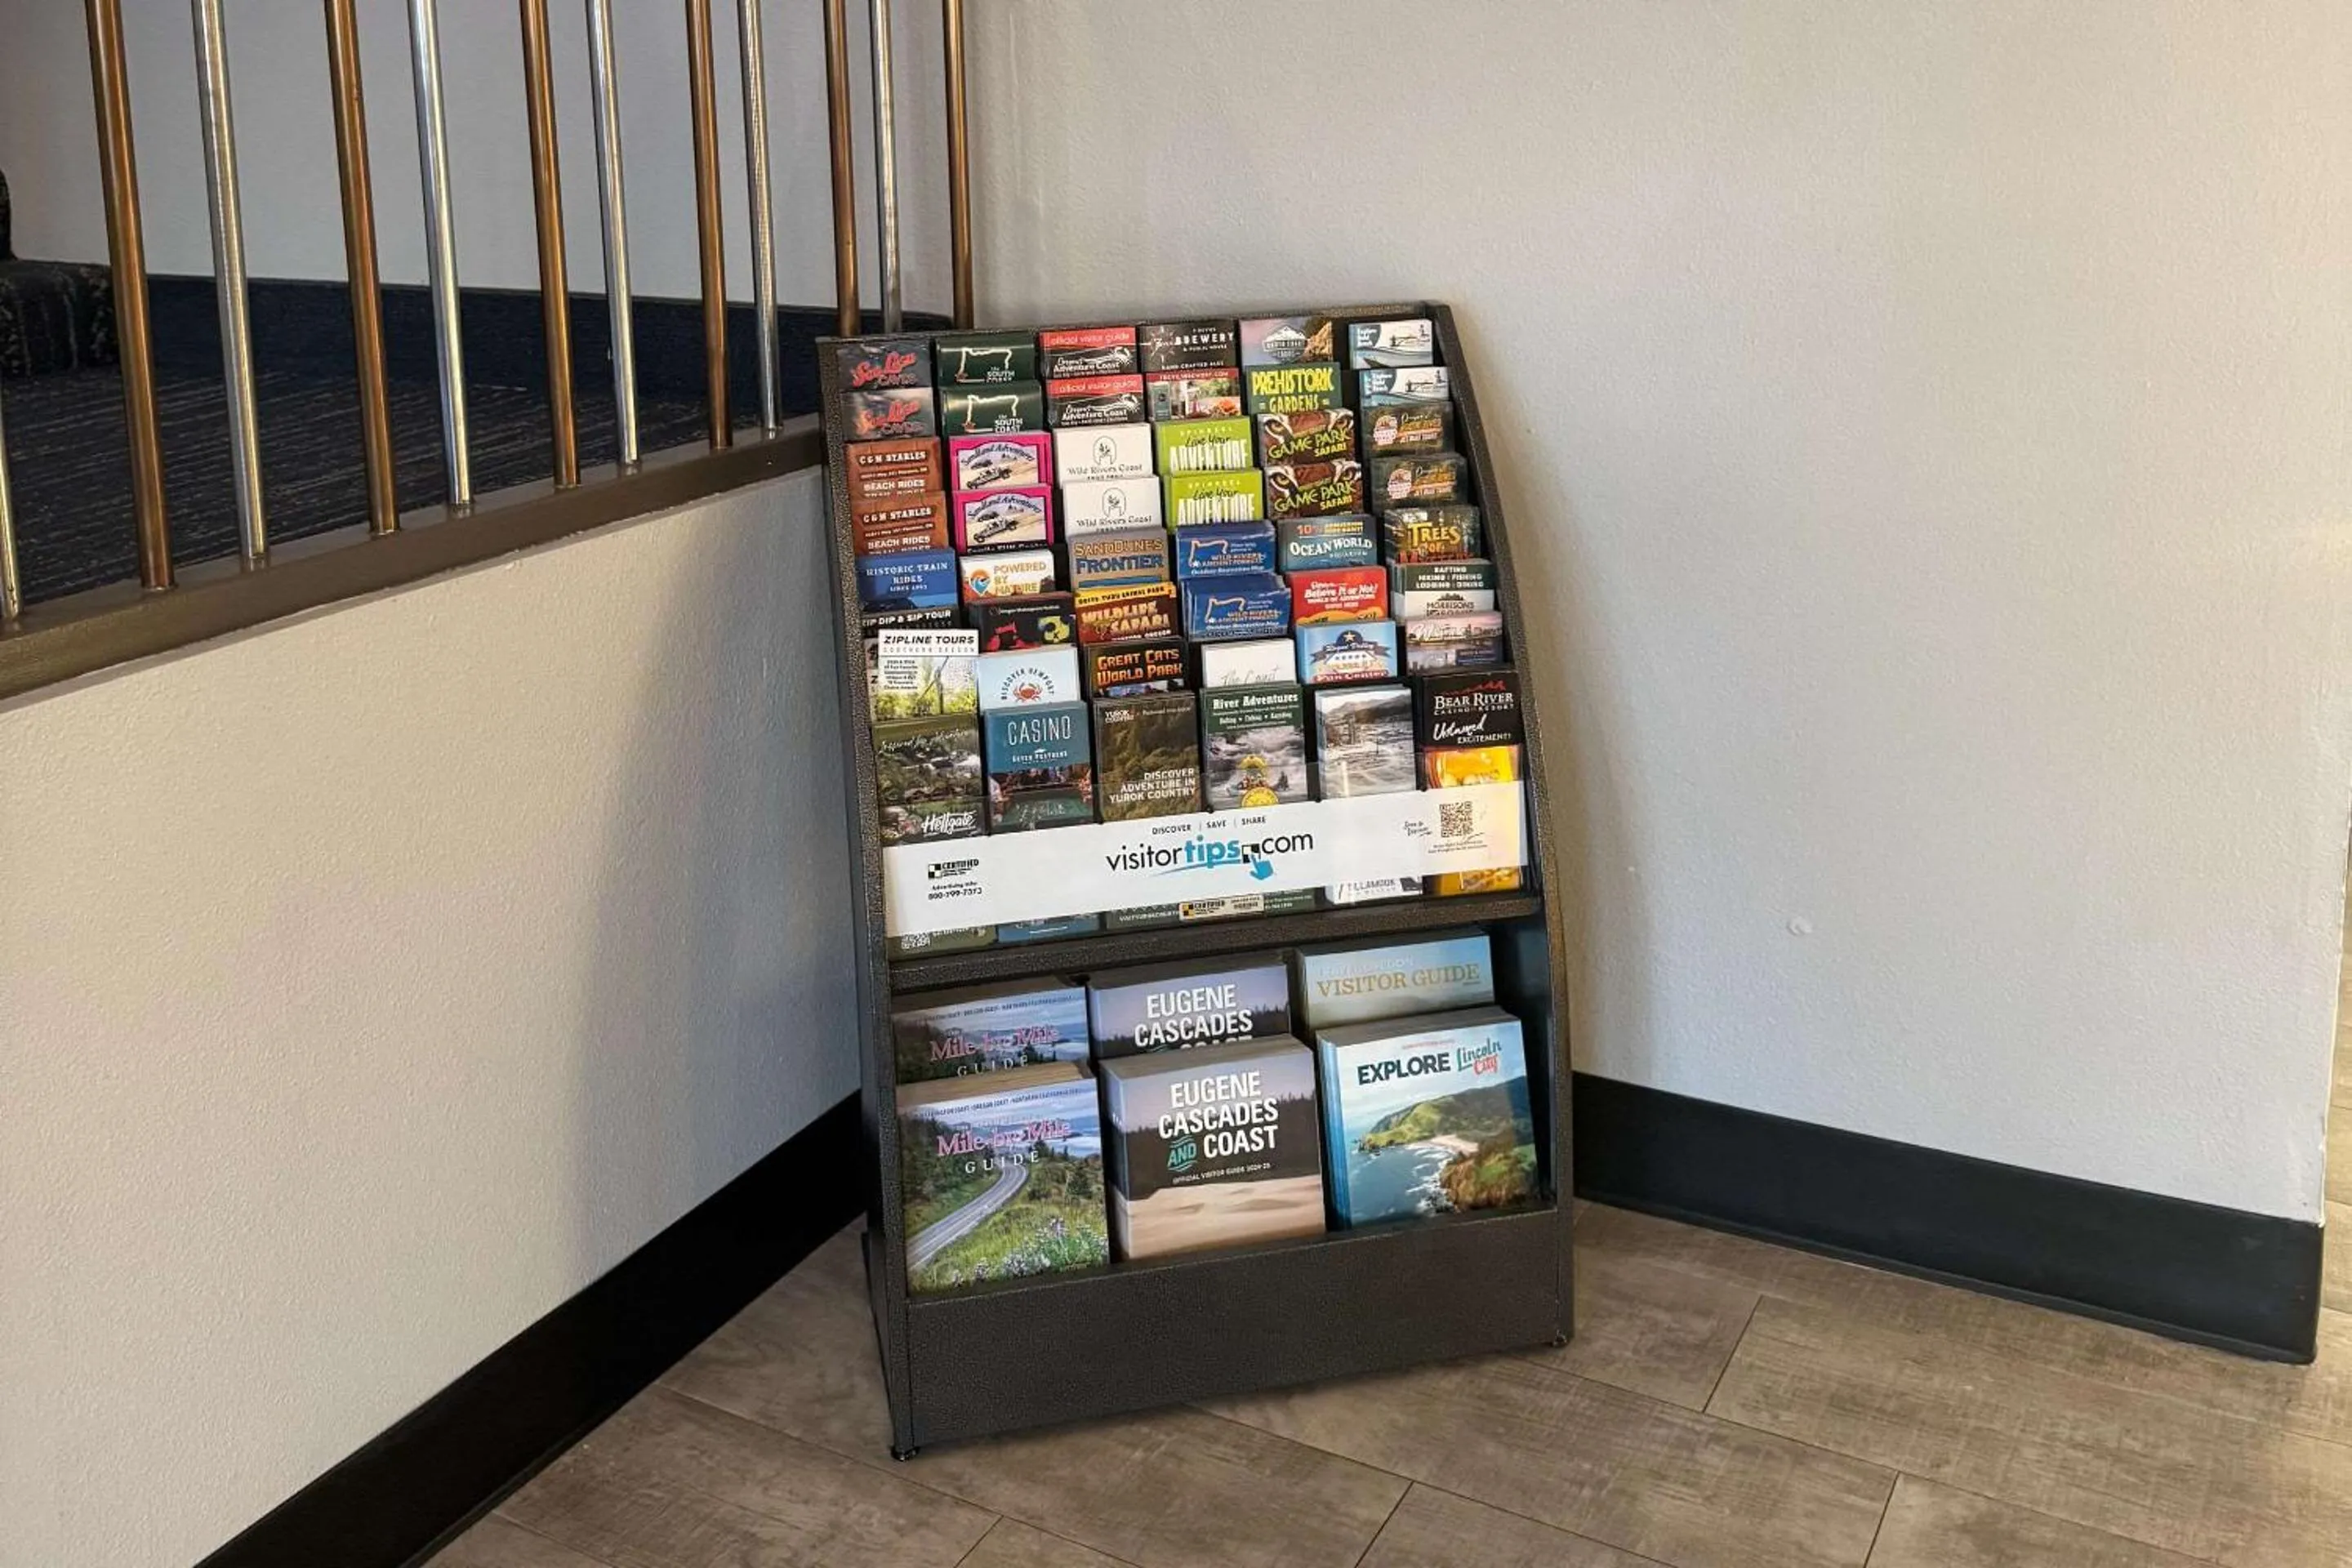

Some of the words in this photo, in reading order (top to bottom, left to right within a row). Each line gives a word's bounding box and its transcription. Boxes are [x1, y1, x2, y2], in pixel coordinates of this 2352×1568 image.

[1106, 332, 1130, 343] guide
[1175, 332, 1234, 345] BREWERY
[1054, 363, 1097, 373] Adventure
[1097, 360, 1120, 369] Coast
[1269, 394, 1320, 412] GARDENS
[994, 417, 1023, 426] SOUTH
[1062, 412, 1102, 421] Adventure
[1102, 409, 1128, 417] Coast
[995, 425, 1021, 434] COAST
[1208, 435, 1232, 447] Your
[1268, 435, 1313, 459] GAME
[1314, 428, 1352, 448] PARK
[886, 451, 927, 462] STABLES
[1169, 439, 1248, 471] ADVENTURE
[1313, 443, 1347, 457] SAFARI
[1067, 466, 1089, 475] Wild
[1118, 463, 1143, 472] Coast
[862, 479, 896, 491] BEACH
[898, 478, 925, 489] RIDES
[1215, 488, 1239, 501] Your
[1273, 488, 1319, 512] GAME
[1320, 480, 1358, 501] PARK
[1178, 493, 1254, 525] ADVENTURE
[1320, 497, 1353, 510] SAFARI
[890, 506, 933, 520] STABLES
[1076, 519, 1098, 528] Wild
[1128, 515, 1152, 524] Coast
[867, 536, 899, 550] BEACH
[902, 535, 931, 547] RIDES
[1407, 522, 1461, 546] TREES
[866, 565, 914, 577] HISTORIC
[917, 562, 948, 572] TRAIN
[993, 561, 1047, 573] POWERED
[1075, 555, 1164, 574] FRONTIER
[893, 575, 924, 585] RIDES
[994, 576, 1008, 585] BY
[994, 582, 1038, 595] NATURE
[1304, 587, 1337, 599] Believe
[879, 617, 897, 626] DIP
[906, 613, 924, 622] SIP
[925, 609, 951, 620] TOUR
[1081, 600, 1158, 623] WILDLIFE
[1111, 613, 1170, 632] SAFARI
[884, 635, 933, 644] ZIPLINE
[935, 635, 975, 644] TOURS
[1097, 652, 1141, 672] GREAT
[1145, 648, 1180, 663] CATS
[1097, 669, 1144, 686] WORLD
[1146, 663, 1183, 679] PARK
[1213, 698, 1240, 710] River
[1242, 693, 1298, 706] Adventures
[1434, 696, 1470, 710] BEAR
[1472, 693, 1514, 706] RIVER
[1007, 715, 1071, 746] CASINO
[1144, 768, 1195, 781] DISCOVER
[1120, 780, 1183, 793] ADVENTURE
[1185, 777, 1196, 788] IN
[1109, 792, 1147, 804] YUROK
[1147, 787, 1196, 800] COUNTRY
[921, 810, 977, 835] Hellgate
[1152, 824, 1192, 835] DISCOVER
[1206, 819, 1227, 829] SAVE
[1241, 816, 1267, 826] SHARE
[942, 858, 979, 870] CERTIFIED
[1317, 970, 1407, 998] VISITOR
[1412, 963, 1481, 987] GUIDE
[1147, 983, 1237, 1019] EUGENE
[1134, 1009, 1254, 1048] CASCADES
[1456, 1037, 1503, 1073] Lincoln
[957, 1054, 1030, 1078] GUIDE
[1356, 1052, 1451, 1086] EXPLORE
[1473, 1054, 1499, 1076] City
[1170, 1071, 1262, 1108] EUGENE
[1157, 1097, 1280, 1140] CASCADES
[1167, 1143, 1197, 1168] AND
[1203, 1125, 1279, 1159] COAST
[964, 1150, 1040, 1174] GUIDE
[1172, 1174, 1200, 1184] OFFICIAL
[1200, 1170, 1226, 1180] VISITOR
[1225, 1166, 1246, 1176] GUIDE
